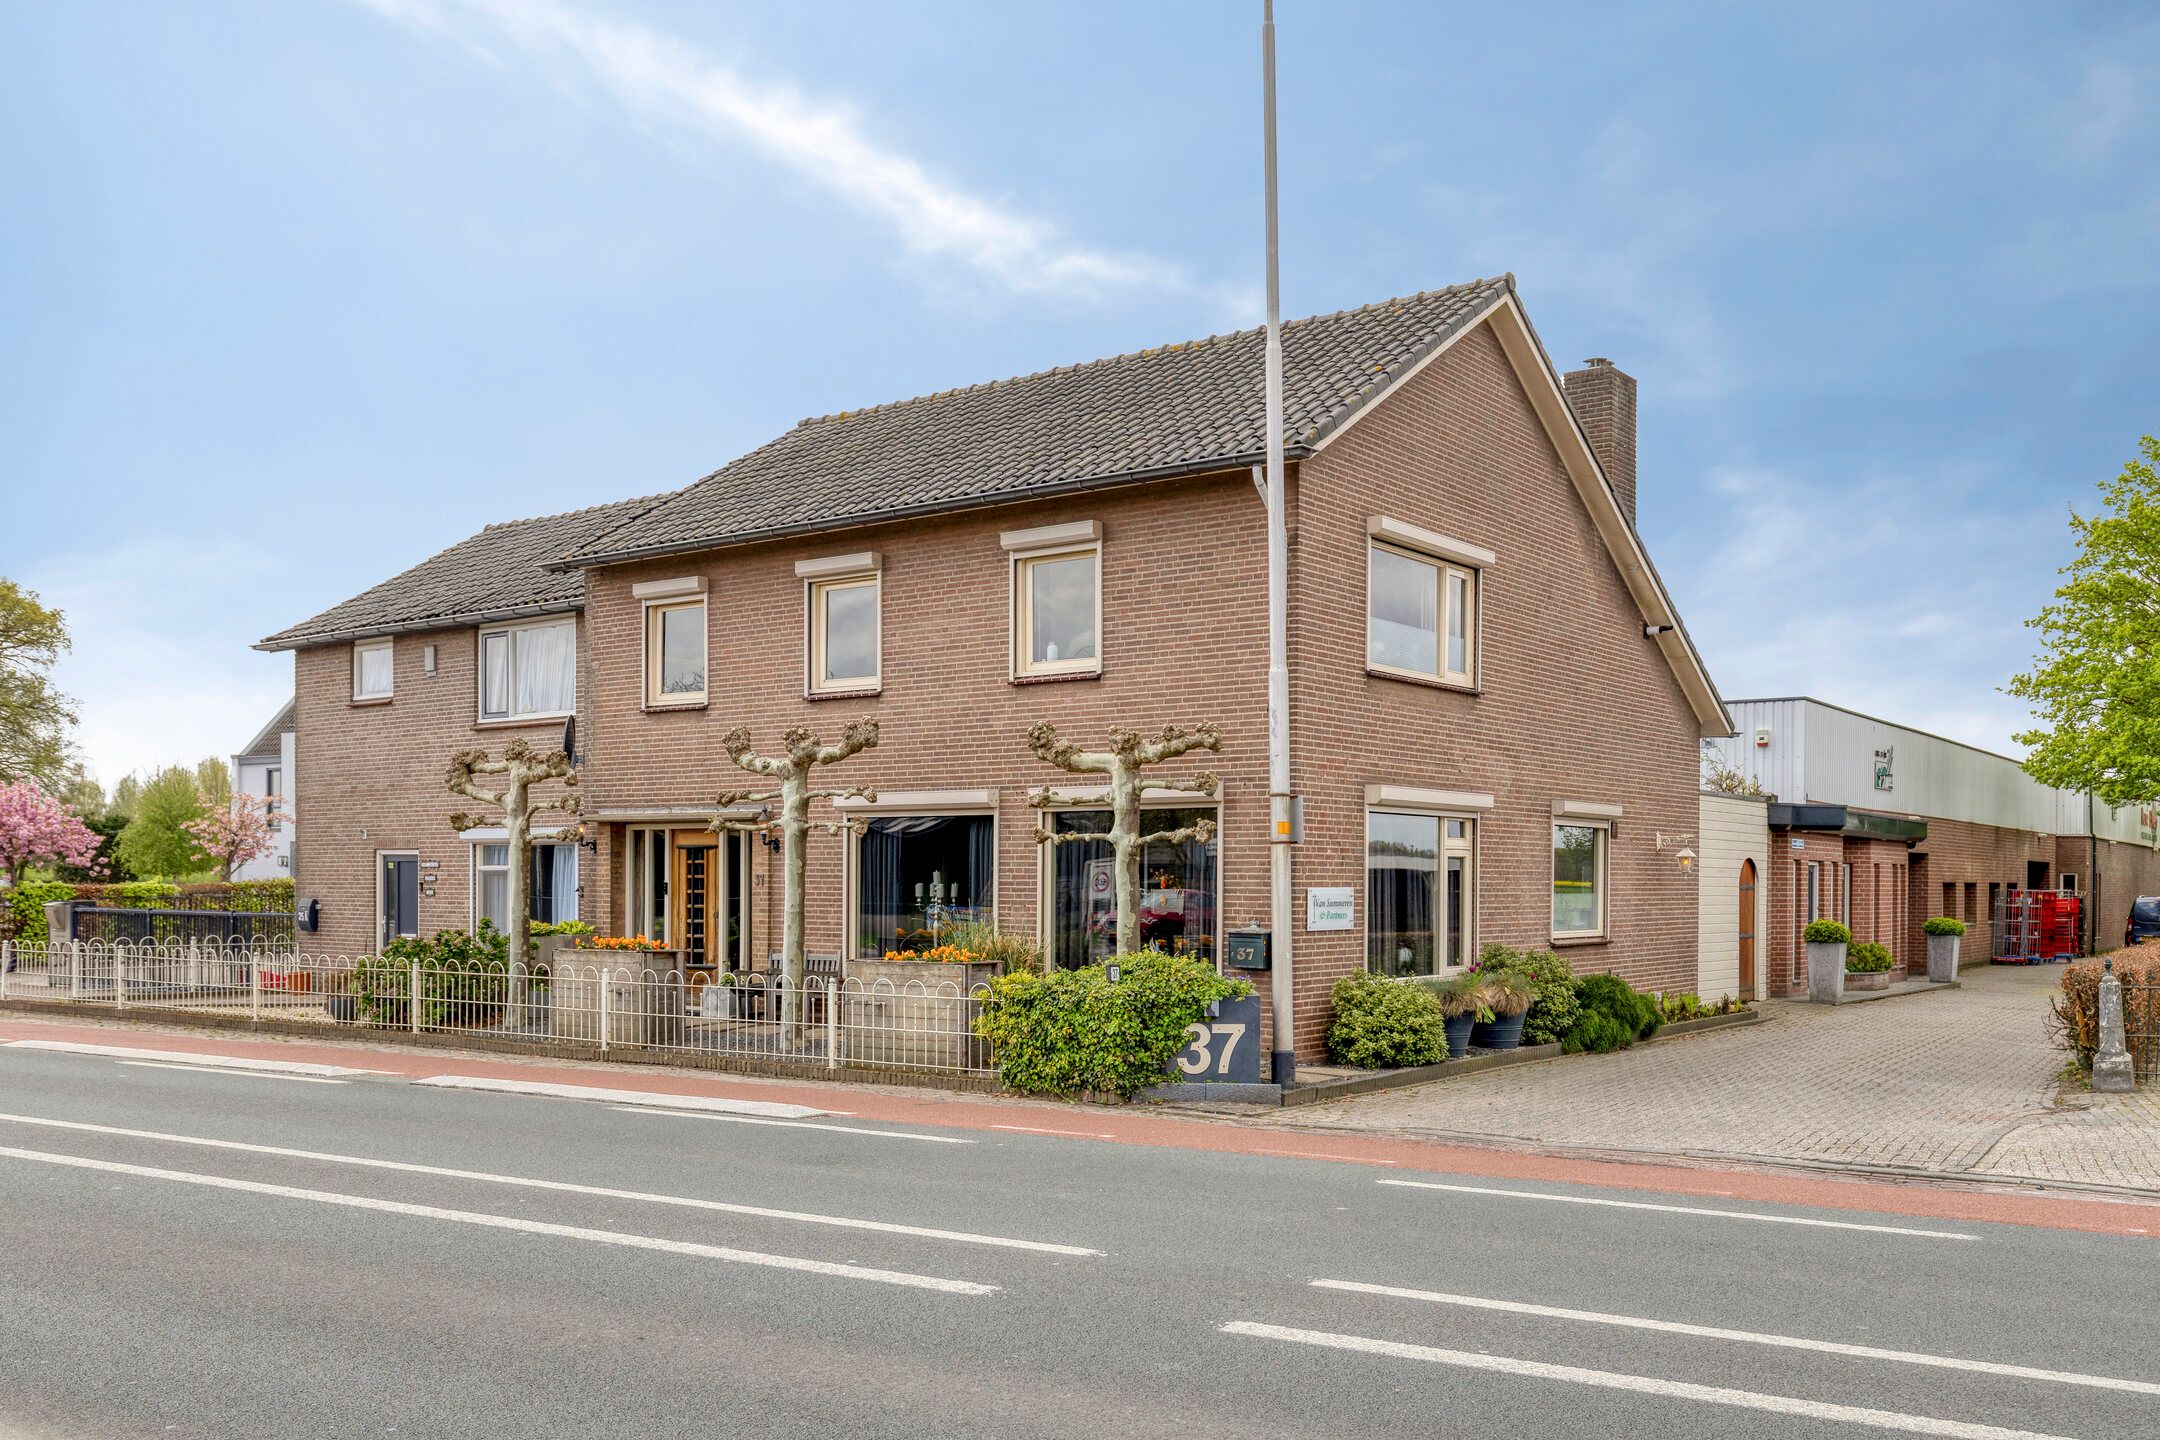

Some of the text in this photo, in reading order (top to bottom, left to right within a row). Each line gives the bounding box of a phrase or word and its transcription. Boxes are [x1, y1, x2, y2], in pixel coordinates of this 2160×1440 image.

[755, 873, 765, 886] 37
[1315, 898, 1326, 907] Van
[1326, 910, 1348, 919] Partners
[1237, 948, 1255, 960] 37
[1177, 1023, 1246, 1075] 37
